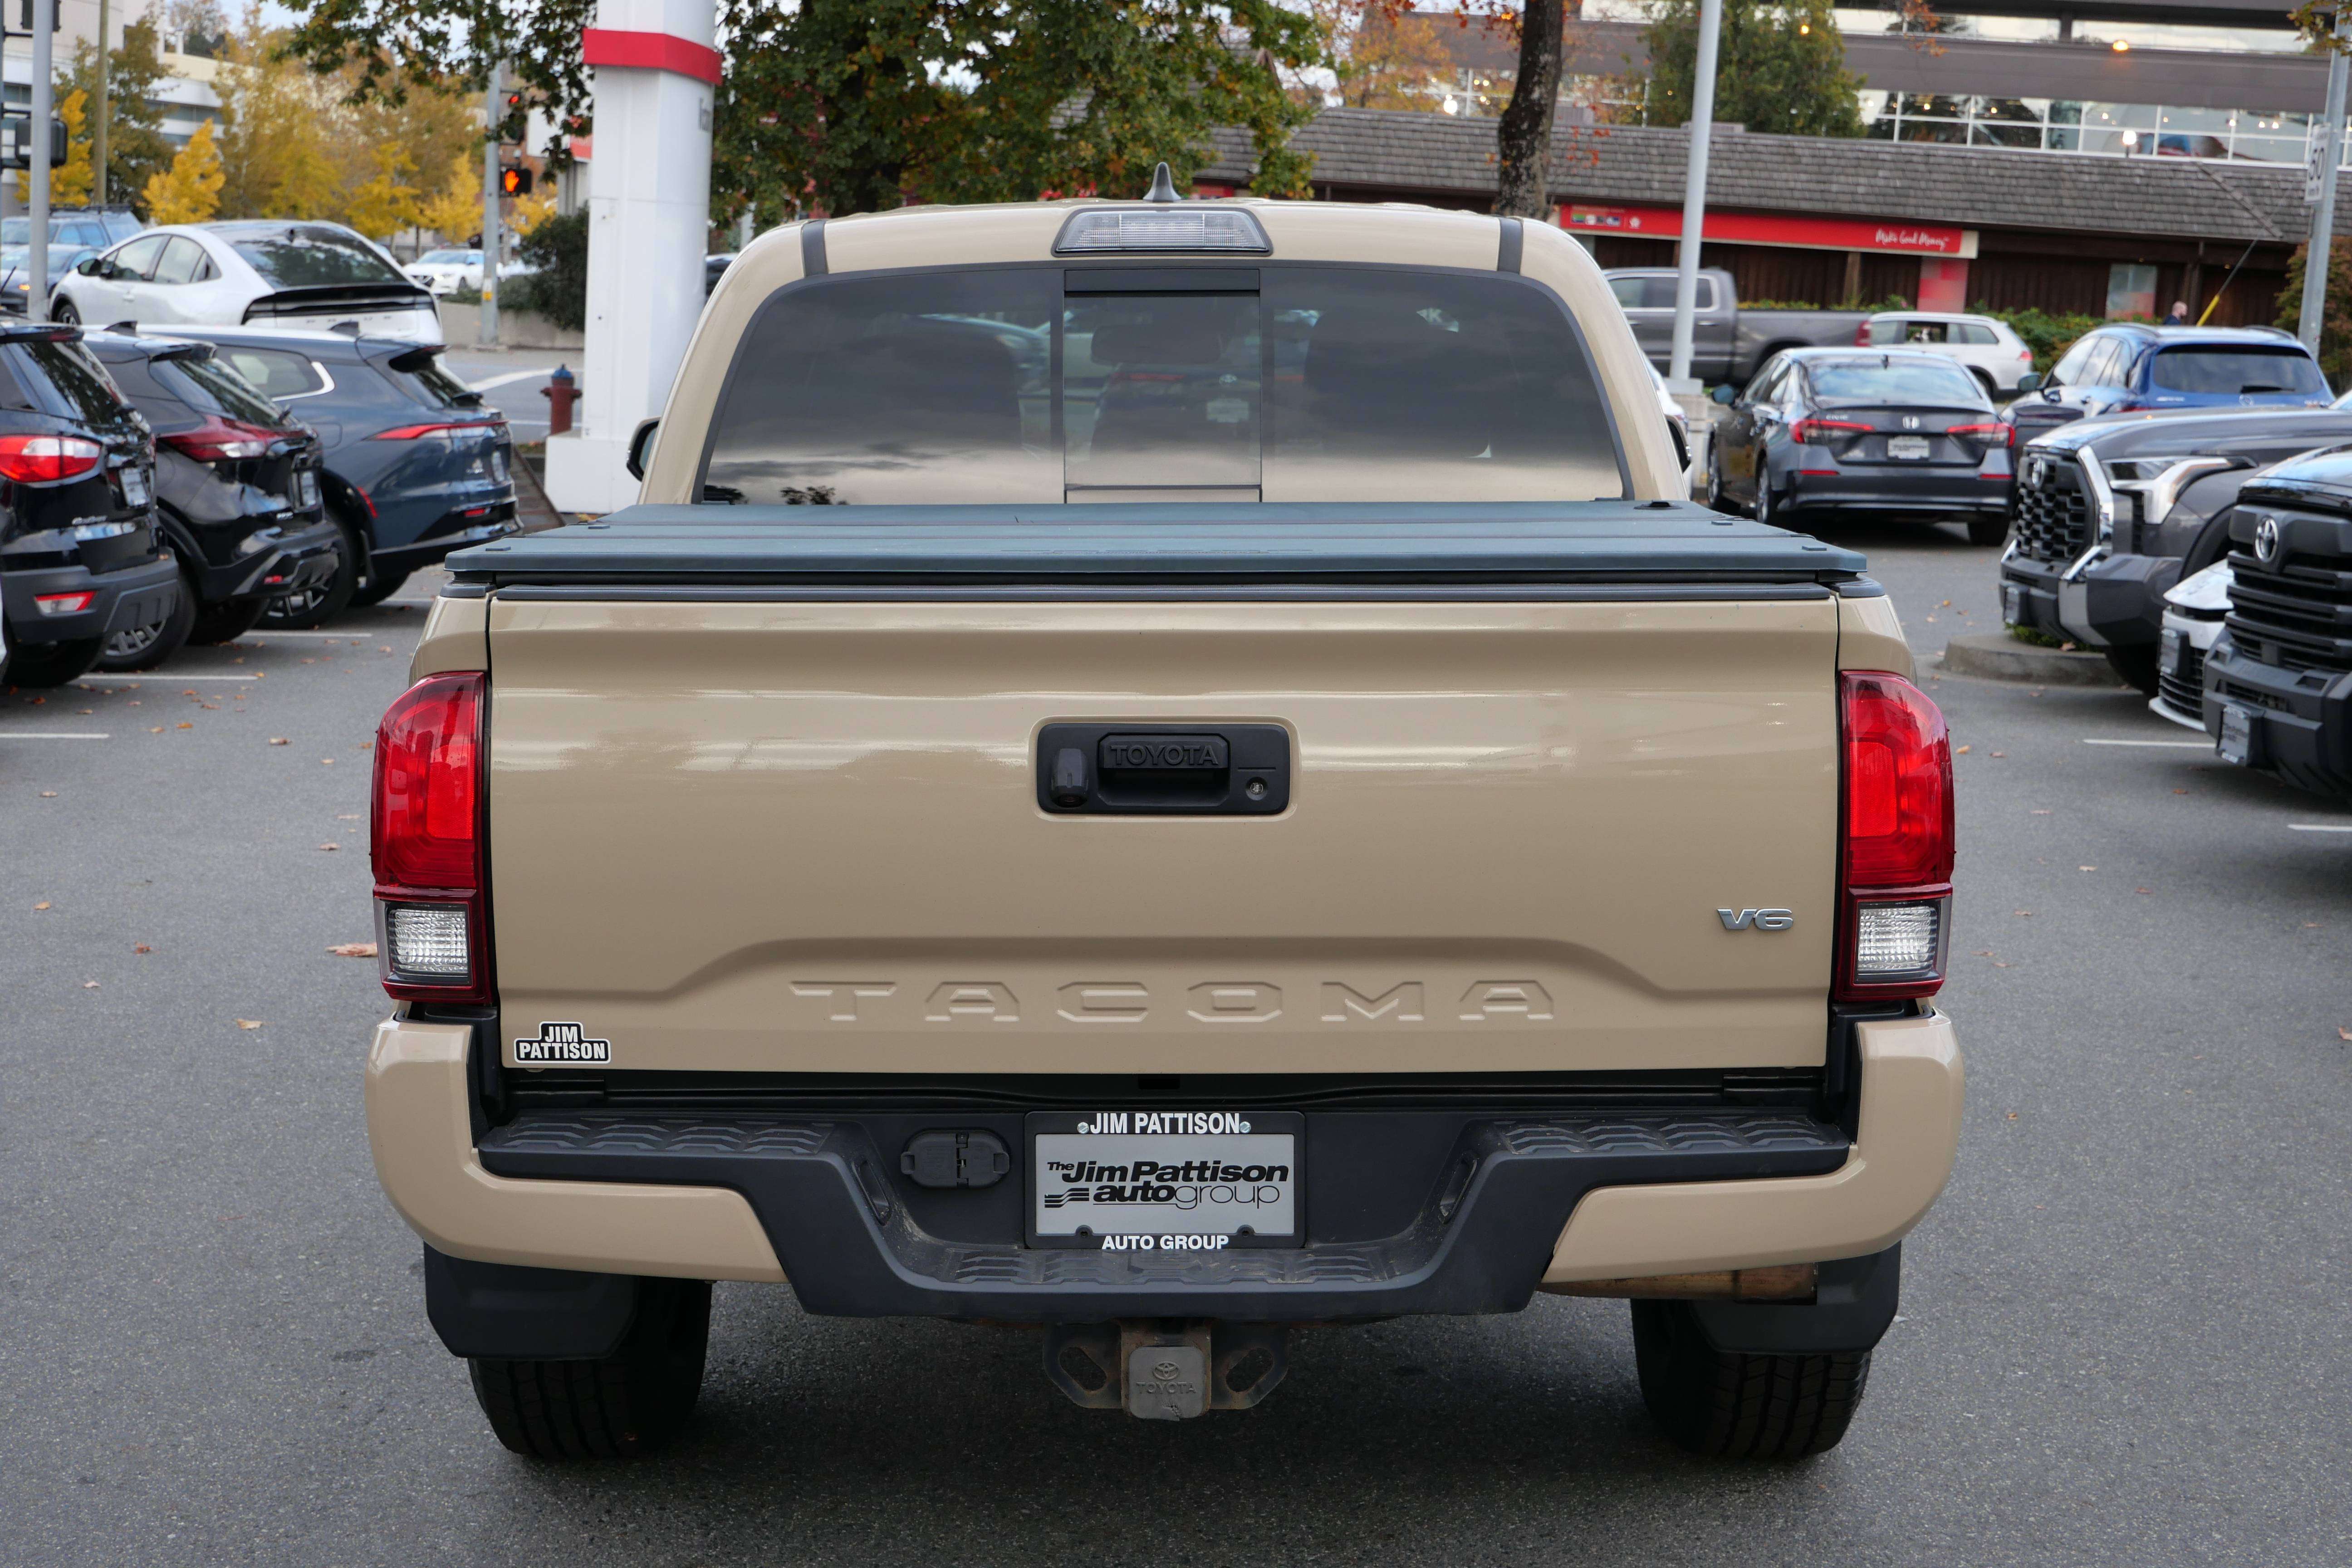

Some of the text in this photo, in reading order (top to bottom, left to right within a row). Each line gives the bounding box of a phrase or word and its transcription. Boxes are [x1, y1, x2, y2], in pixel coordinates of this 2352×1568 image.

[2308, 147, 2325, 180] 50
[1110, 744, 1220, 766] TOYOTA
[1717, 908, 1793, 930] V6
[790, 980, 1554, 1022] TACOMA
[544, 1026, 578, 1043] JIM
[519, 1042, 606, 1059] PATTISON
[1090, 1112, 1240, 1133] JIM PATTISON
[1047, 1160, 1289, 1182] The Jim Pattison
[1102, 1235, 1229, 1250] AUTO GROUP
[1136, 1382, 1197, 1394] TOYOTA
